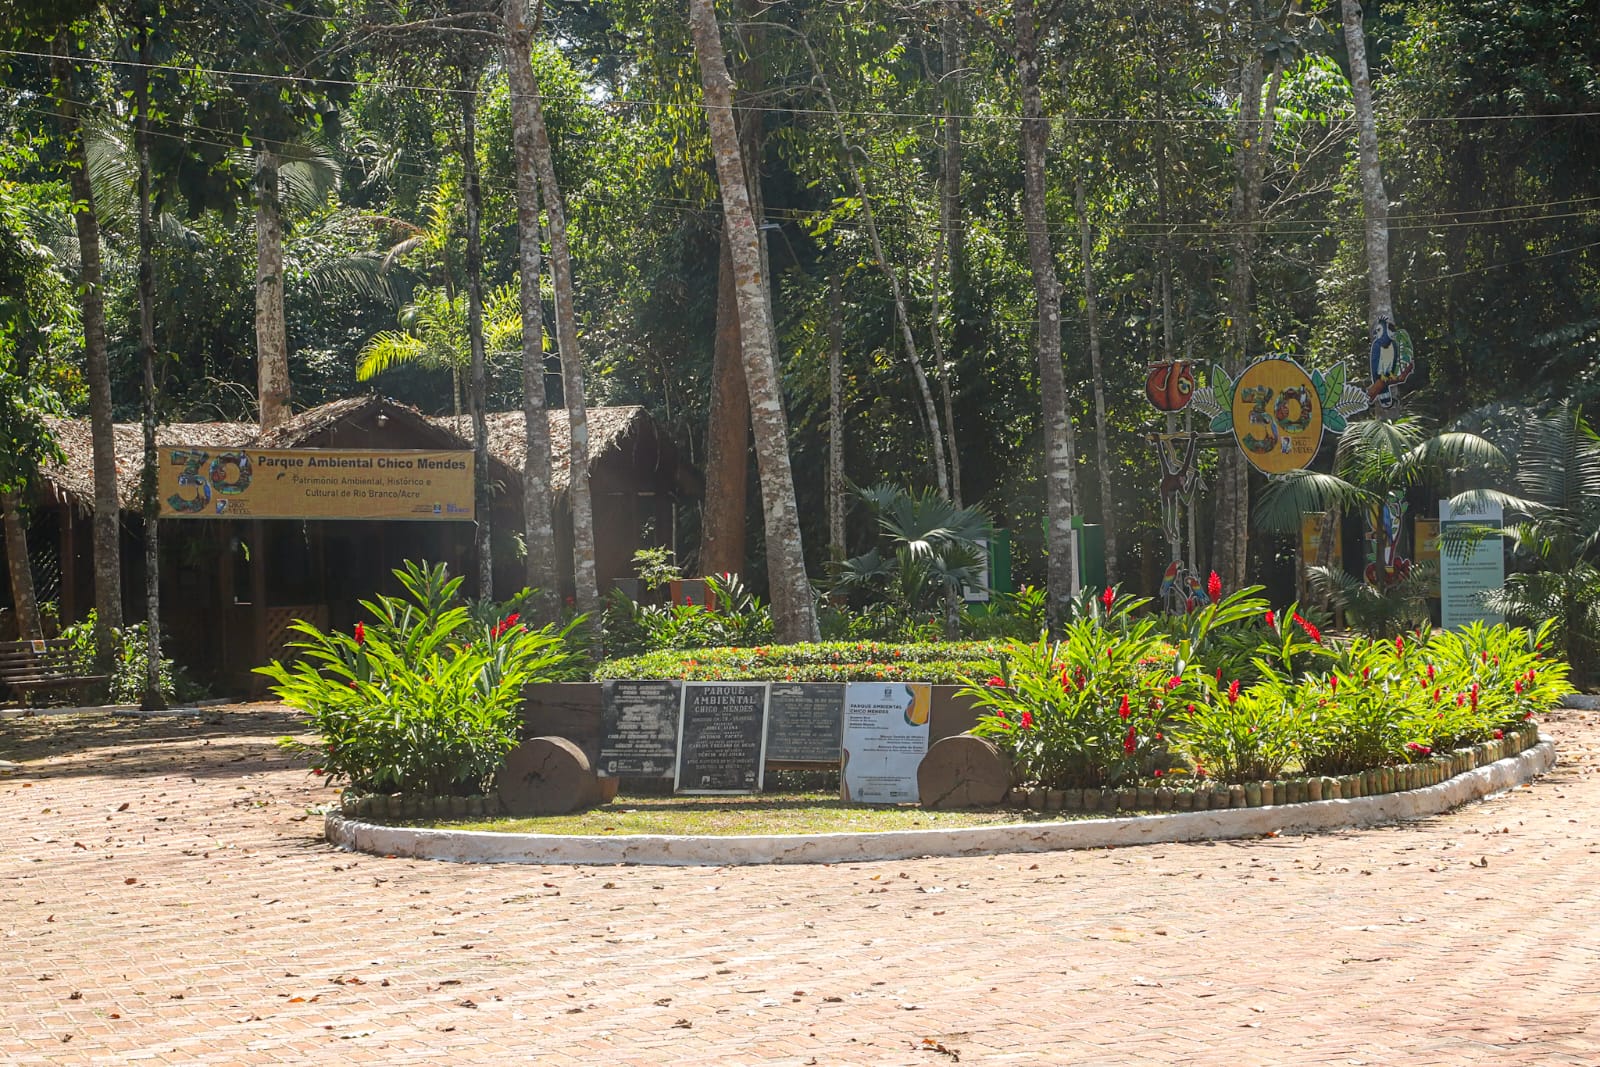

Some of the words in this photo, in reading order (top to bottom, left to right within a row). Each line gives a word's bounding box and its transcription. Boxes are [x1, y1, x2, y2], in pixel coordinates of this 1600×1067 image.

[1241, 384, 1312, 454] 30
[258, 456, 304, 469] Parque
[308, 457, 373, 469] Ambiental
[377, 458, 413, 469] Chico
[417, 458, 466, 470] Mendes
[166, 449, 253, 514] 30
[293, 475, 339, 485] Patrimônio
[341, 476, 384, 486] Ambiental,
[387, 476, 422, 486] Histórico
[305, 489, 338, 498] Cultural
[341, 489, 350, 498] de
[353, 489, 367, 498] Rio
[369, 489, 420, 499] Branco/Acre
[704, 686, 745, 695] PARQUE
[693, 695, 757, 705] AMBIENTAL
[694, 705, 718, 713] CHICO
[723, 705, 753, 713] MENDES
